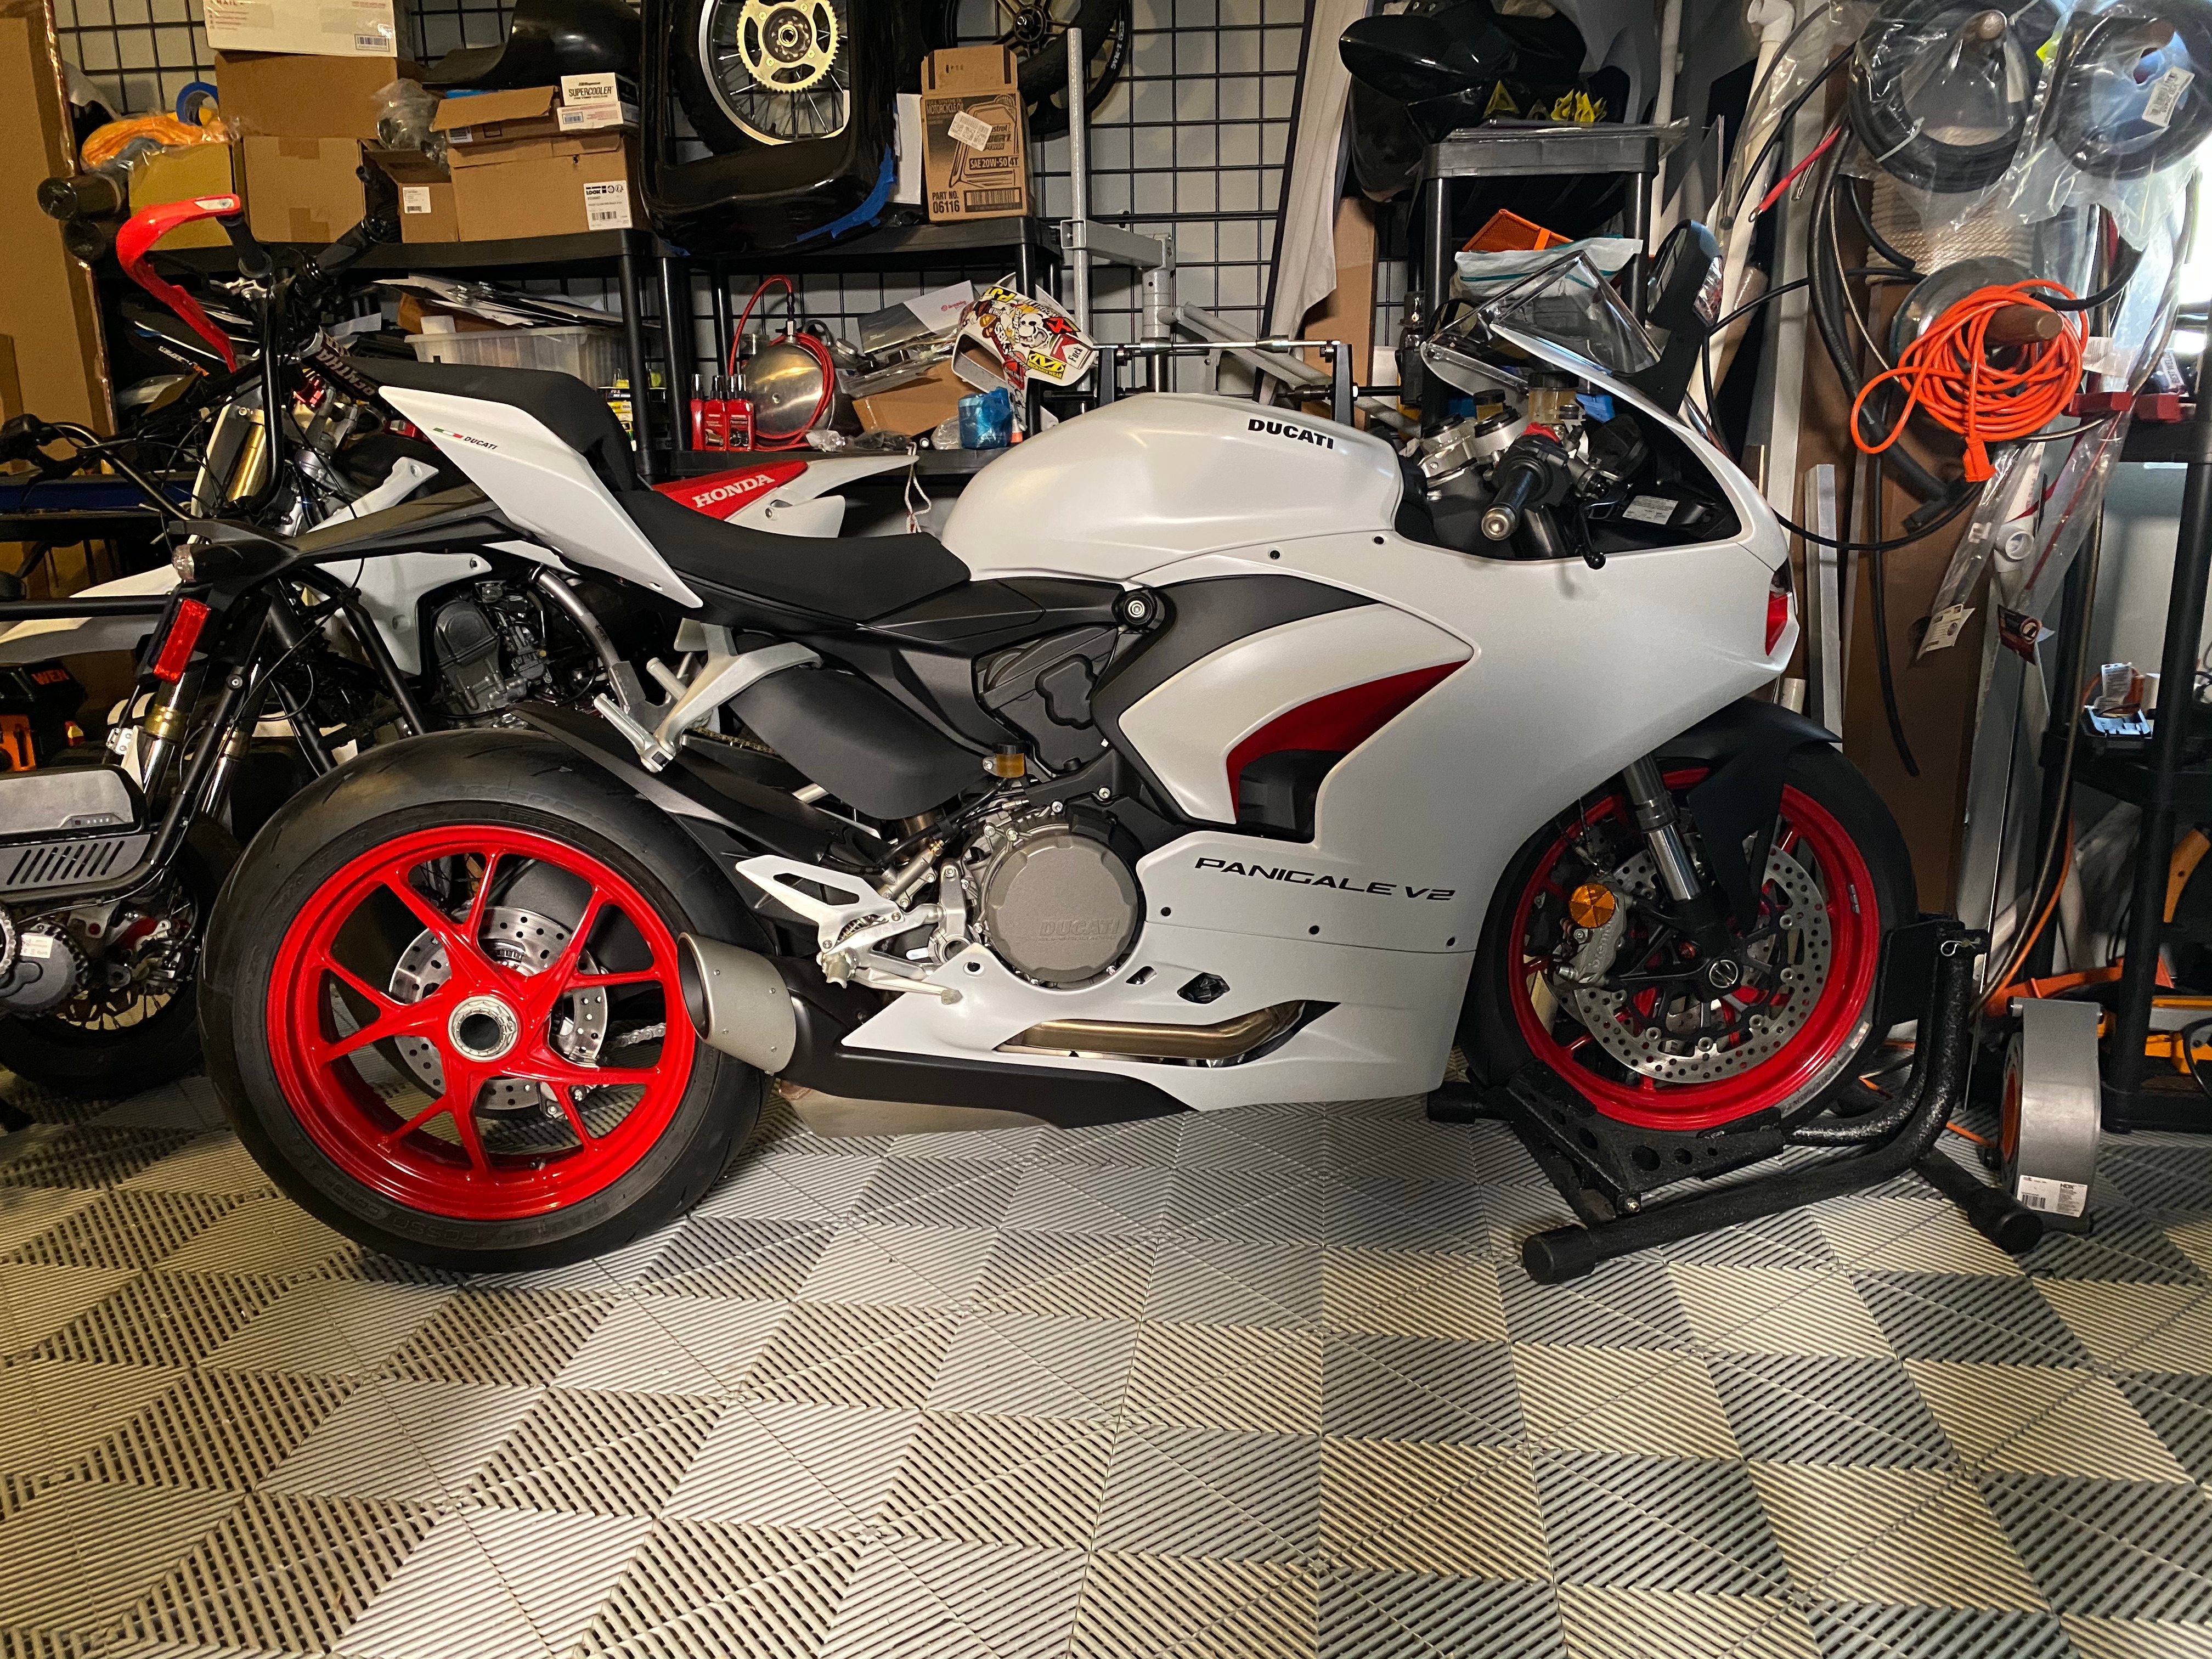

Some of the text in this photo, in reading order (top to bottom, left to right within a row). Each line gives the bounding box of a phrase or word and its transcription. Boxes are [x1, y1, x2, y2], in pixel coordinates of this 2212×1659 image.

[569, 86, 612, 97] SUPERCOOLER
[927, 103, 956, 114] MOTORCYCLE
[985, 143, 1005, 151] -TWIN
[970, 159, 981, 168] SAE
[982, 157, 1008, 167] 20W-50
[932, 190, 959, 201] PART NO.
[933, 200, 960, 214] 06116
[1068, 347, 1084, 362] Fuck
[314, 347, 376, 396] RENTHA
[1248, 418, 1334, 450] DUCATI
[464, 436, 498, 450] DUCATI
[692, 474, 775, 508] HONDA
[31, 669, 70, 685] WEN
[1195, 857, 1456, 901] PANIGALE V2
[1040, 918, 1120, 936] DUCATI
